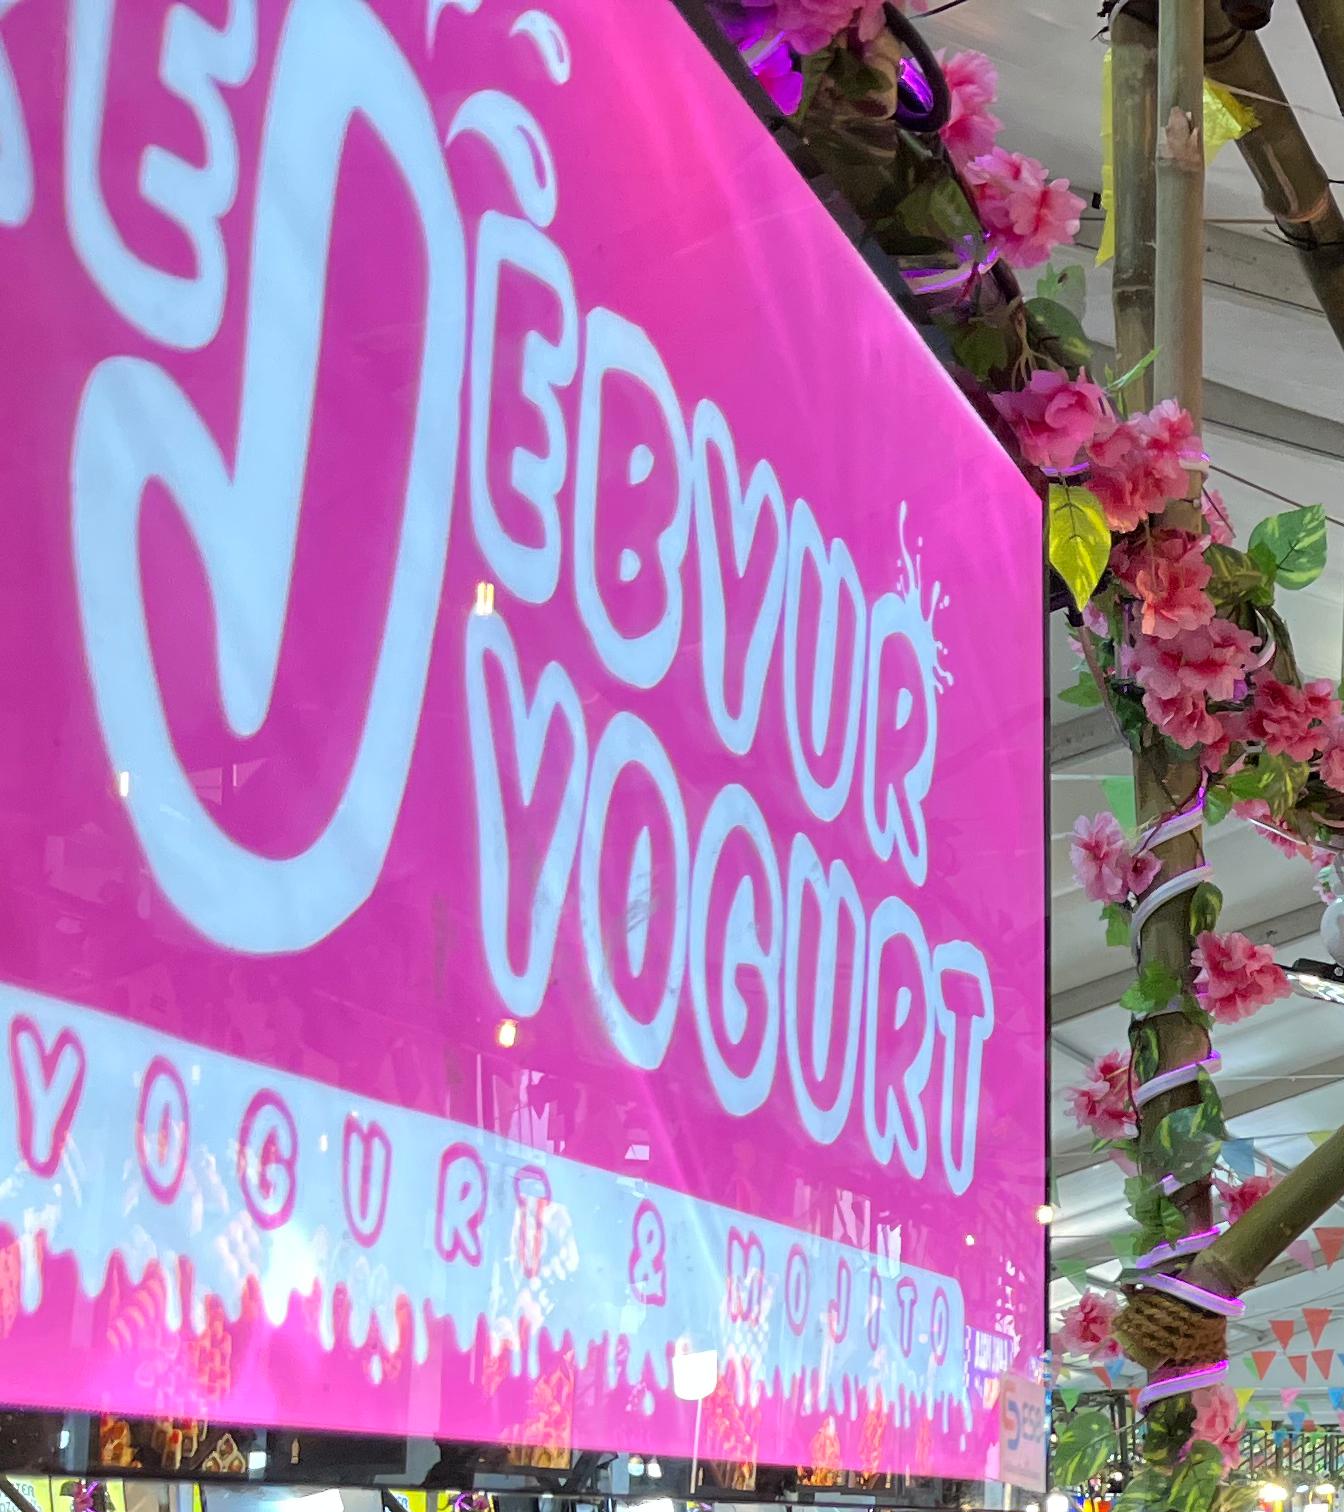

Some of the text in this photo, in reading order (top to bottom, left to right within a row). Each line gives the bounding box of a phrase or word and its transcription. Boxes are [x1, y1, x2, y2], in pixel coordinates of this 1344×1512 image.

[463, 606, 995, 1196] YOGURT
[9, 1013, 953, 1365] YOGURT & MOJITO
